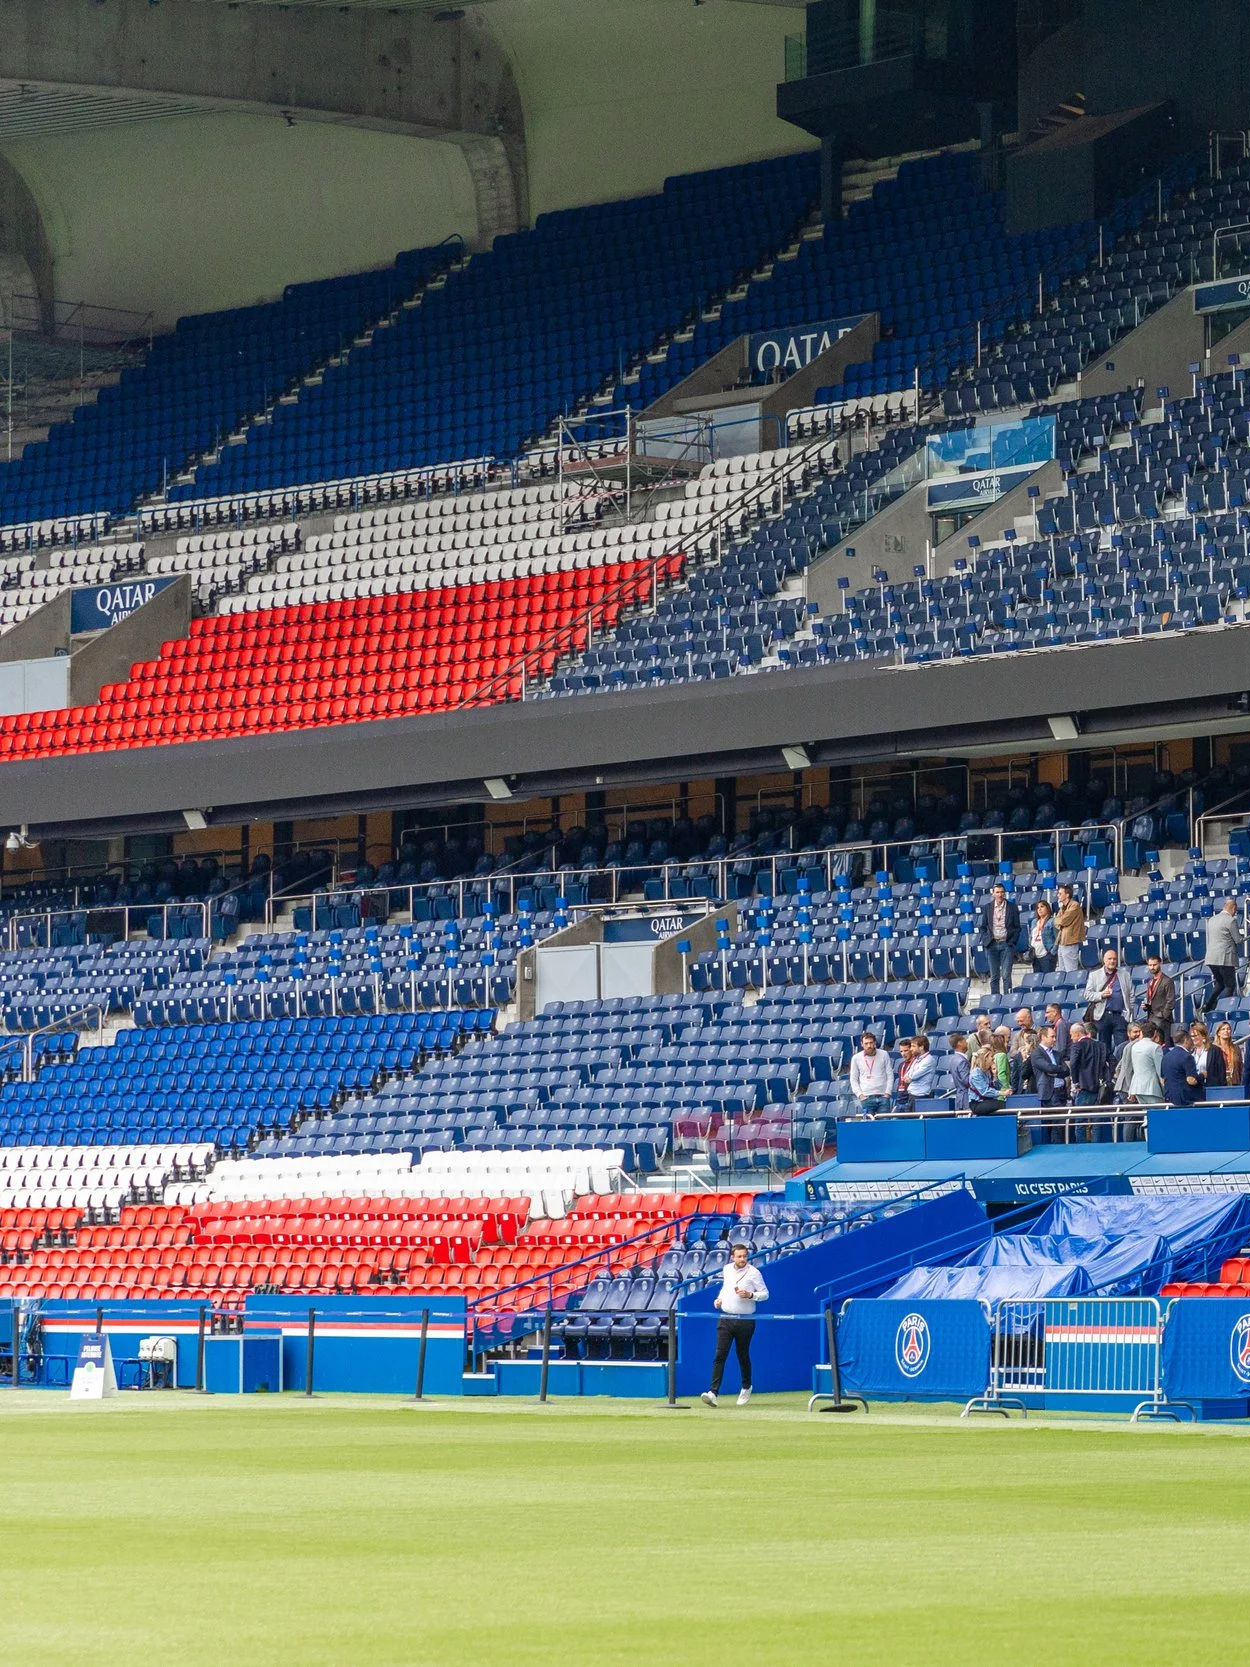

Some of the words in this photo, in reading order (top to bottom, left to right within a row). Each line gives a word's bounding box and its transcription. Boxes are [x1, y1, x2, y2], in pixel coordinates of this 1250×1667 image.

[757, 327, 853, 372] QATA
[972, 476, 1001, 492] QATAR
[96, 583, 155, 616] QATAR
[651, 917, 683, 934] QATAR
[1015, 1183, 1030, 1195] ICI
[1029, 1183, 1057, 1195] C'EST
[902, 1316, 926, 1332] PARIS
